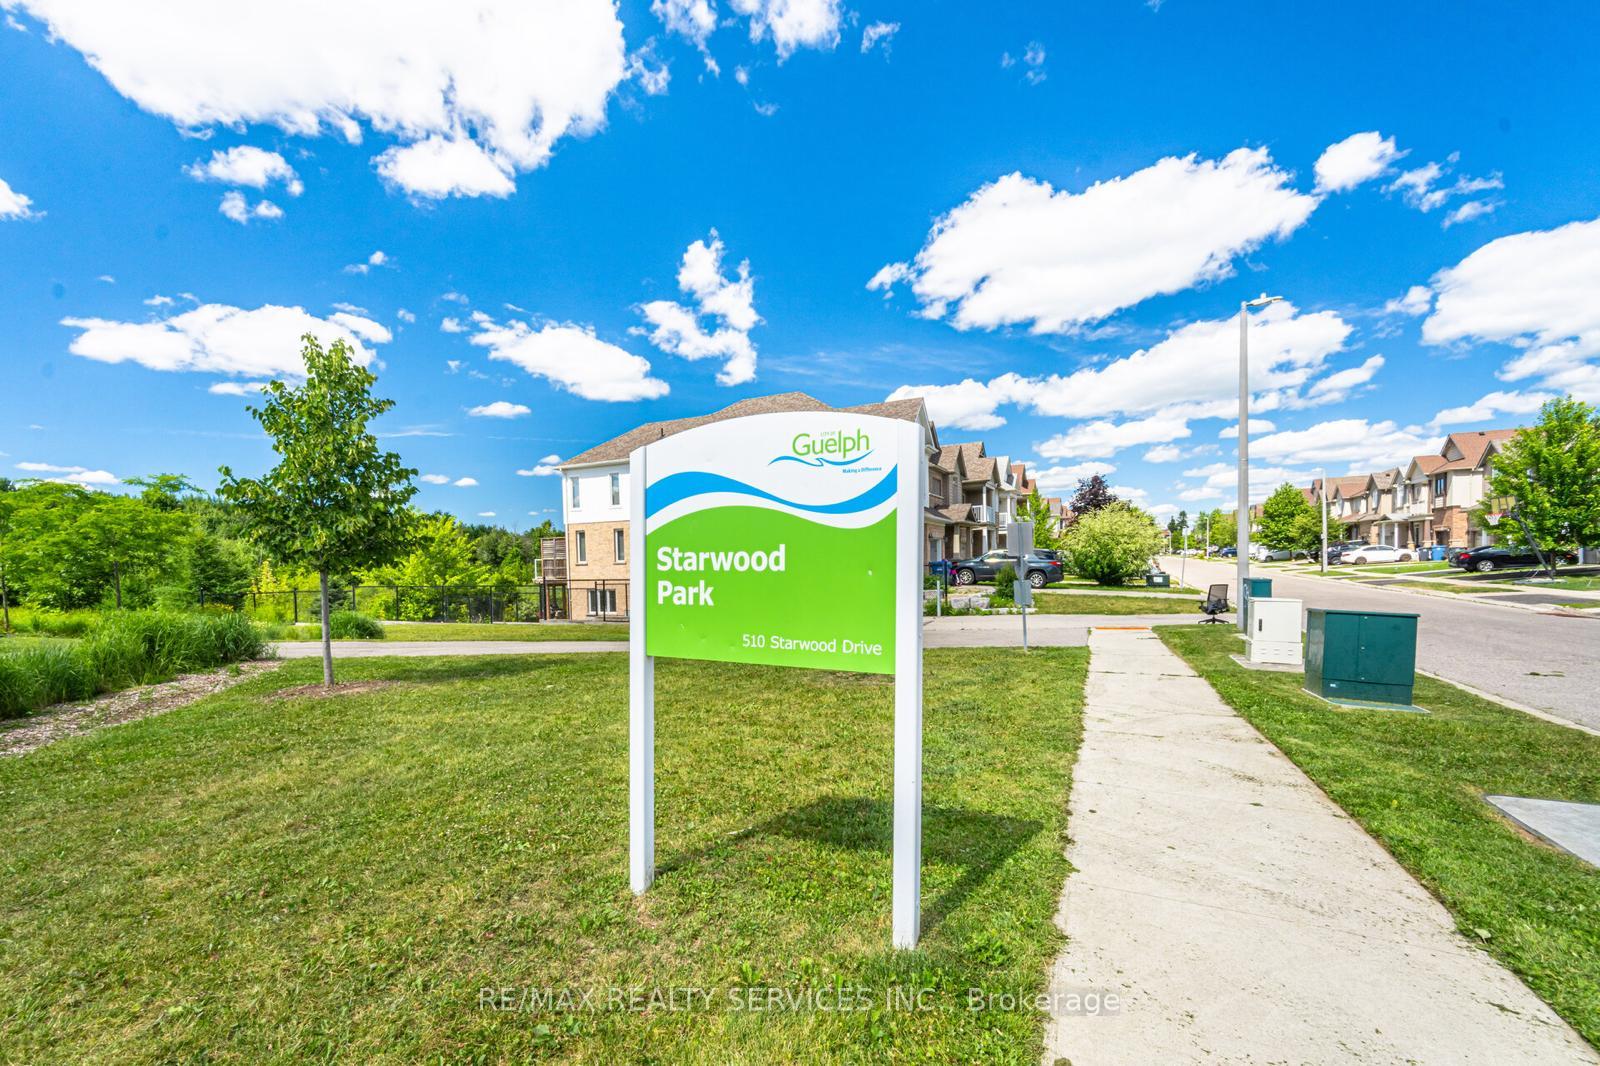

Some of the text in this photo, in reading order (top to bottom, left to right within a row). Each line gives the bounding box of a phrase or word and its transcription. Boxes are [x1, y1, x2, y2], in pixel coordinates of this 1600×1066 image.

[792, 428, 870, 459] Guelph
[656, 544, 786, 572] Starwood
[657, 580, 714, 606] Park
[742, 634, 882, 656] 510 Starwood Drive
